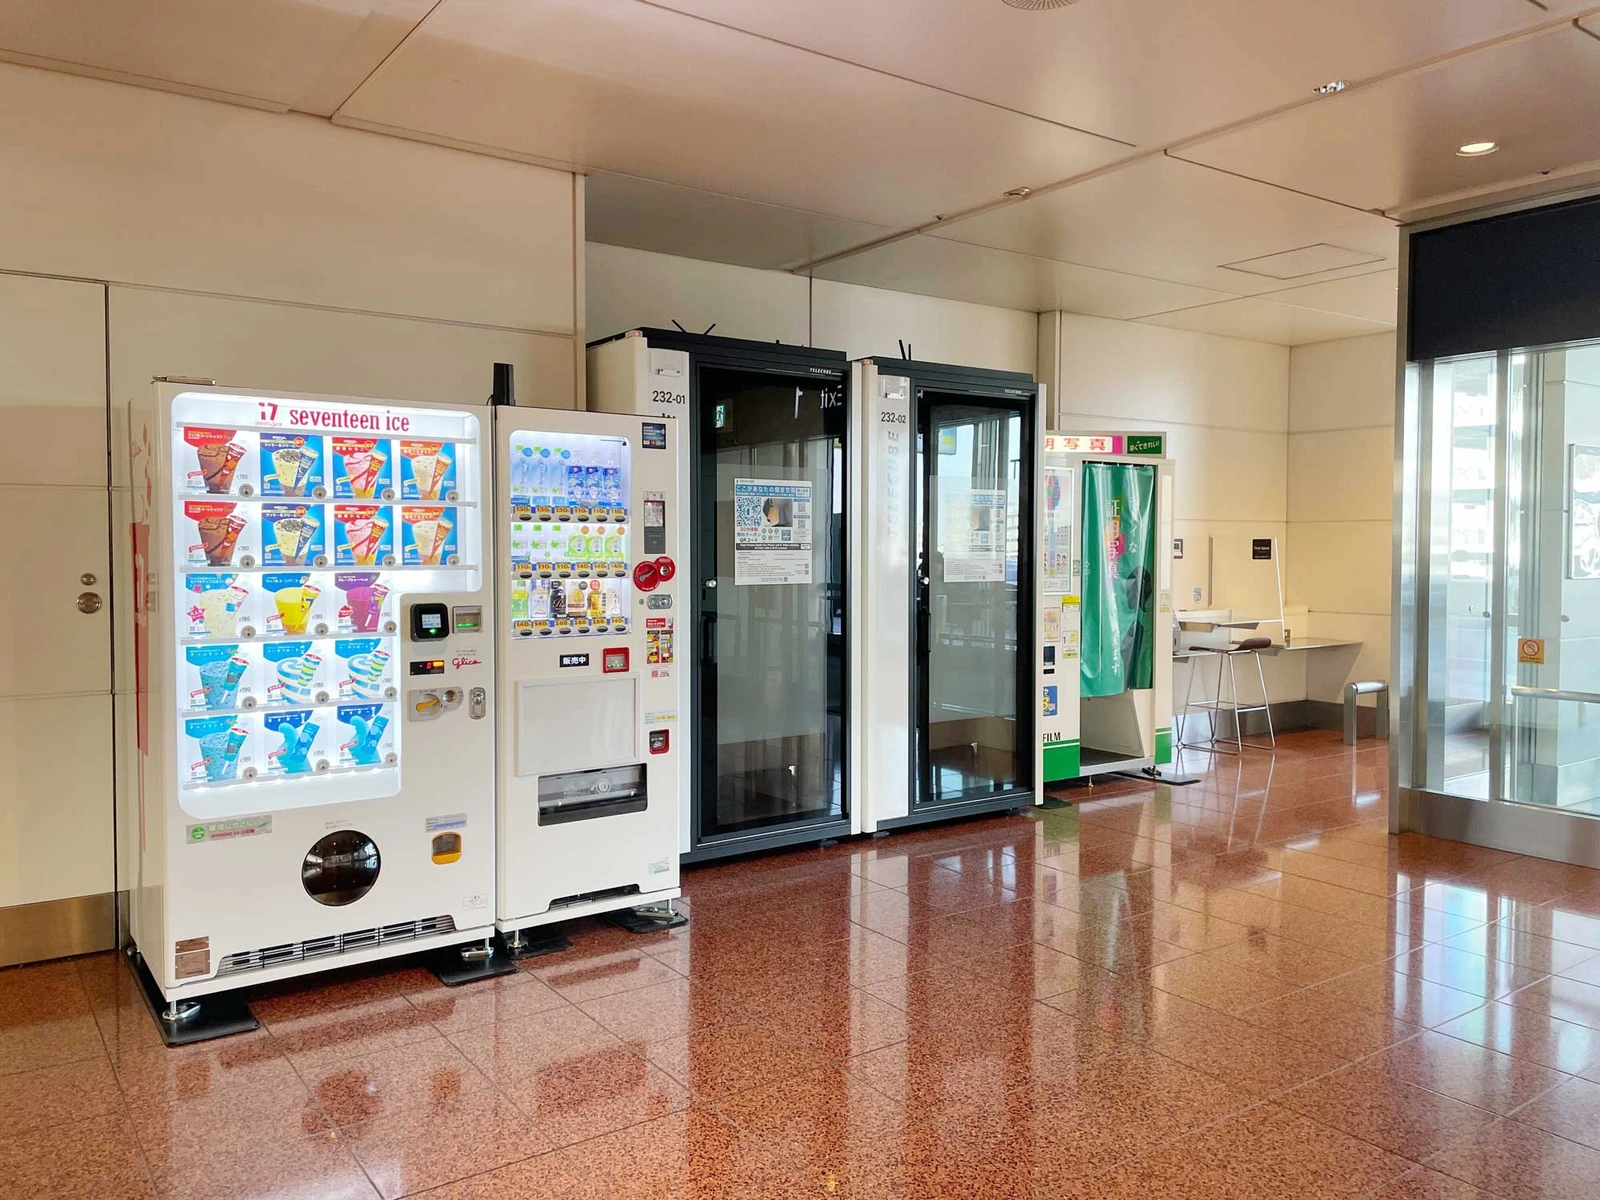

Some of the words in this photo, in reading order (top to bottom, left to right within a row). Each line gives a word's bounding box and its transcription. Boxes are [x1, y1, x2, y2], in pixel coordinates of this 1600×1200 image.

[652, 390, 686, 405] 232-01
[289, 409, 380, 430] seventeen
[386, 410, 410, 431] ice
[880, 411, 907, 424] 232-02
[452, 658, 481, 669] Glico
[563, 654, 586, 665] 販売中
[1043, 732, 1060, 742] FILM
